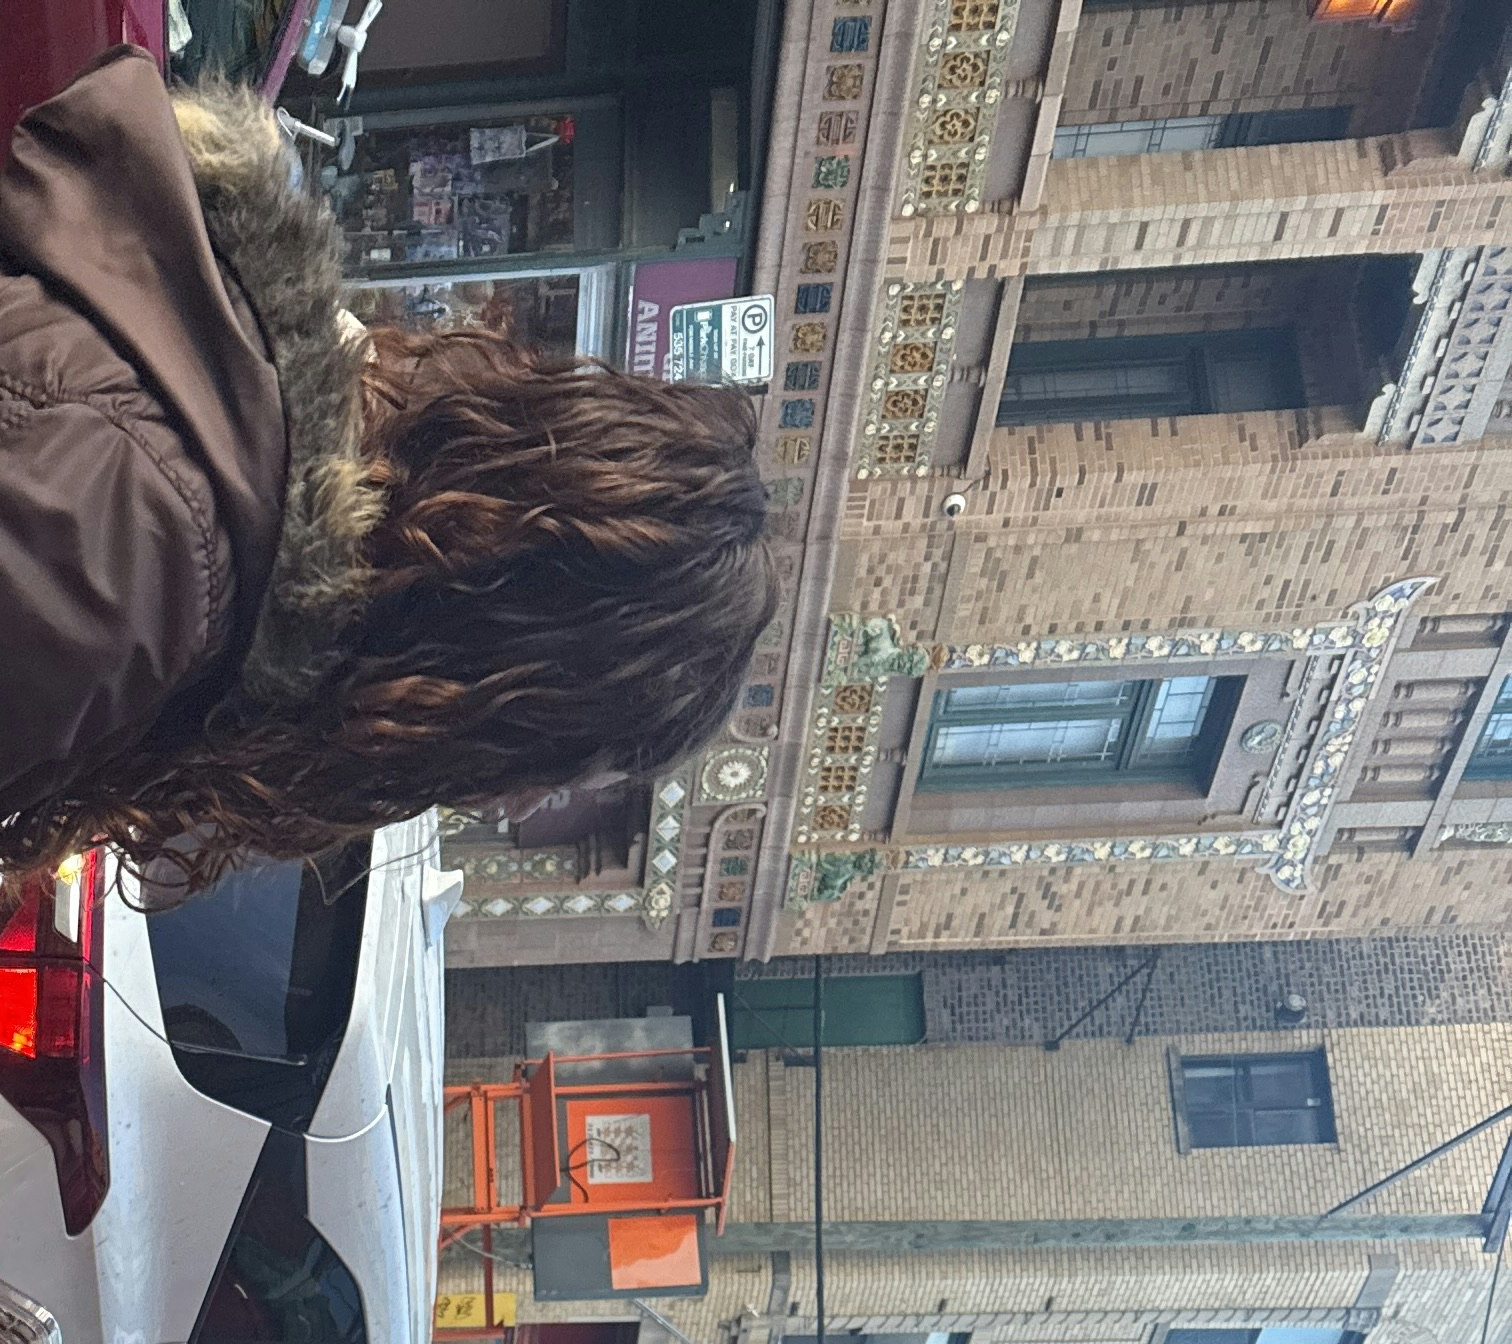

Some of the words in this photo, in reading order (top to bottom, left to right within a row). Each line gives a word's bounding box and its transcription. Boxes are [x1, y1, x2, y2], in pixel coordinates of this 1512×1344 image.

[730, 306, 738, 322] PAY
[730, 325, 738, 338] AT
[730, 338, 738, 356] PAY
